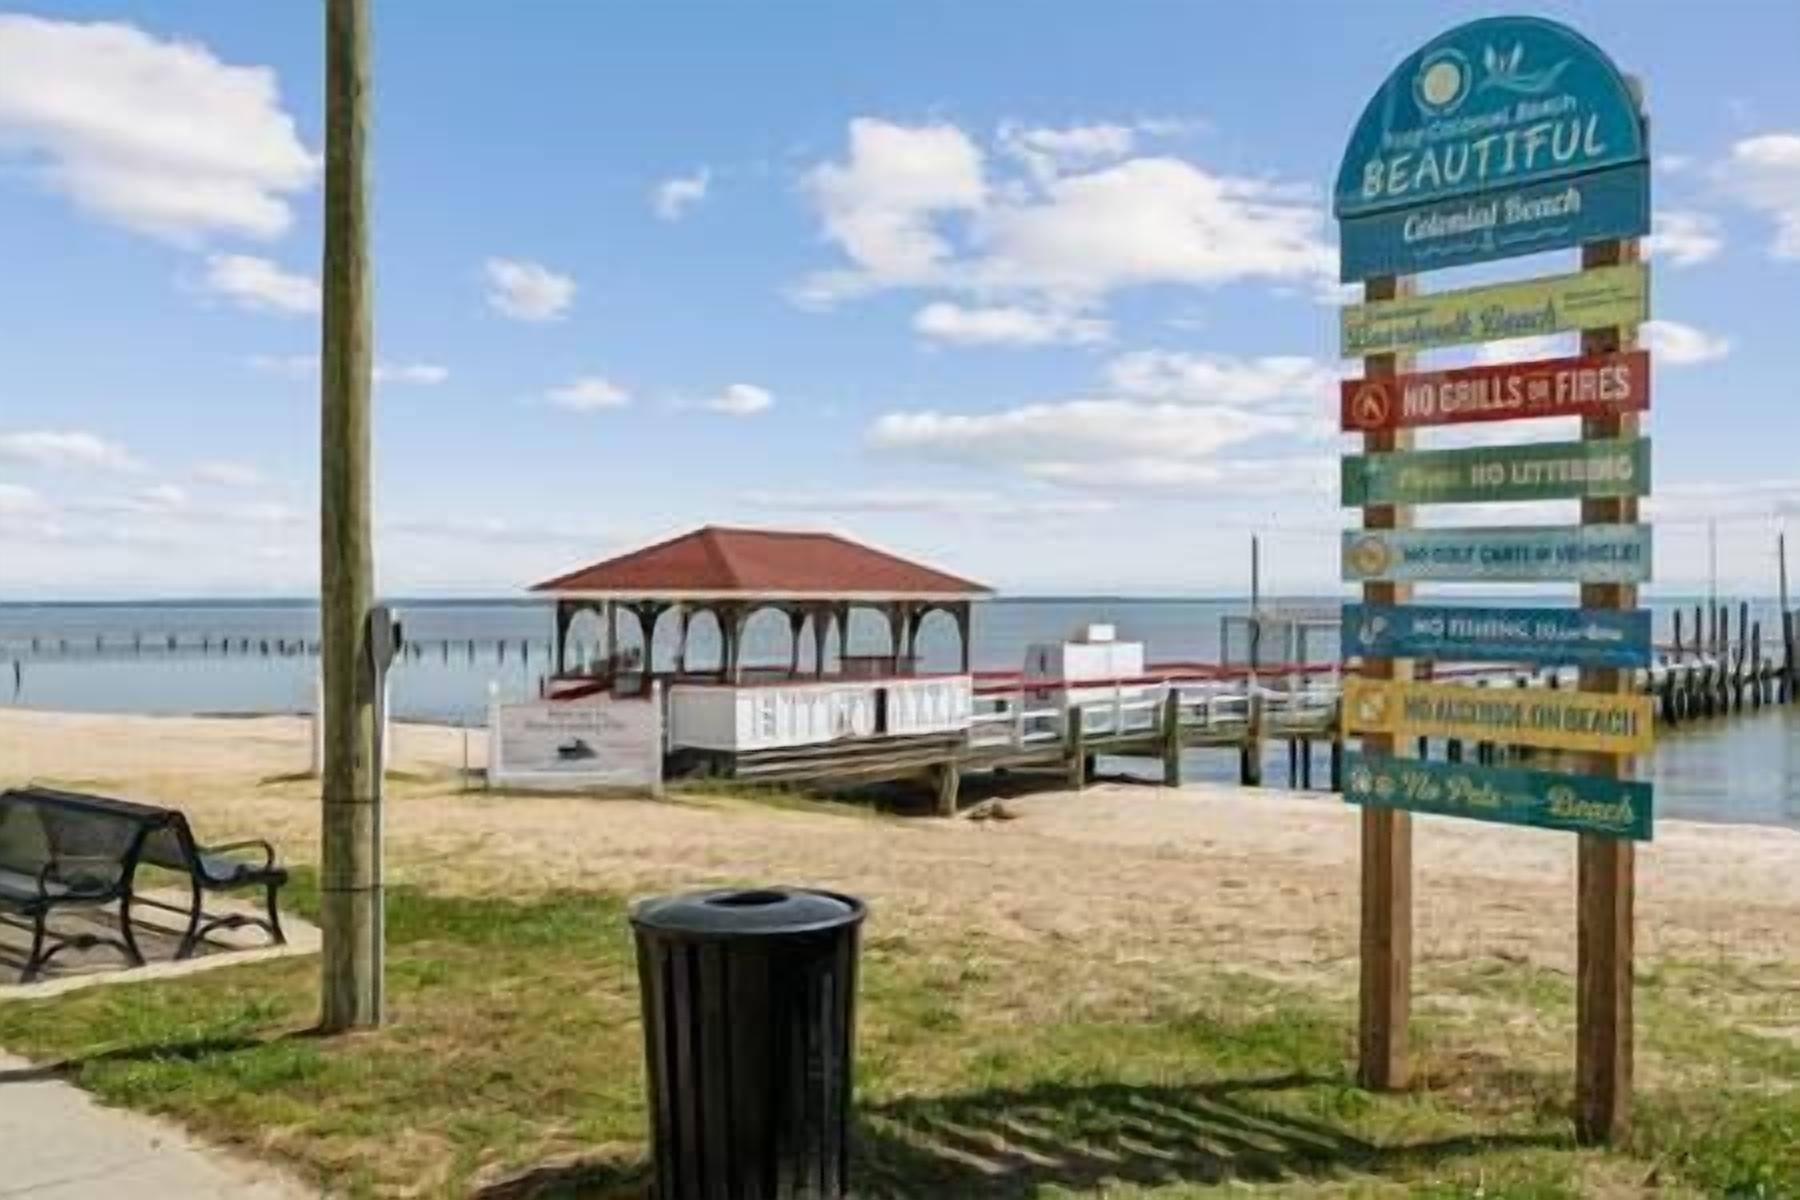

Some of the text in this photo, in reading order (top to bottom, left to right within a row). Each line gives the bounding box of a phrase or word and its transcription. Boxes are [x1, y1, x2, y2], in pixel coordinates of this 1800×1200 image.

[1361, 112, 1607, 199] BEAUTIFUL
[1403, 186, 1582, 242] Colonial Beach
[1402, 383, 1436, 418] NO
[1438, 372, 1524, 413] GRILLS
[1555, 364, 1633, 405] FIRES
[1471, 462, 1505, 487] NO
[1511, 454, 1634, 485] LITTERING
[1411, 617, 1445, 636] NO
